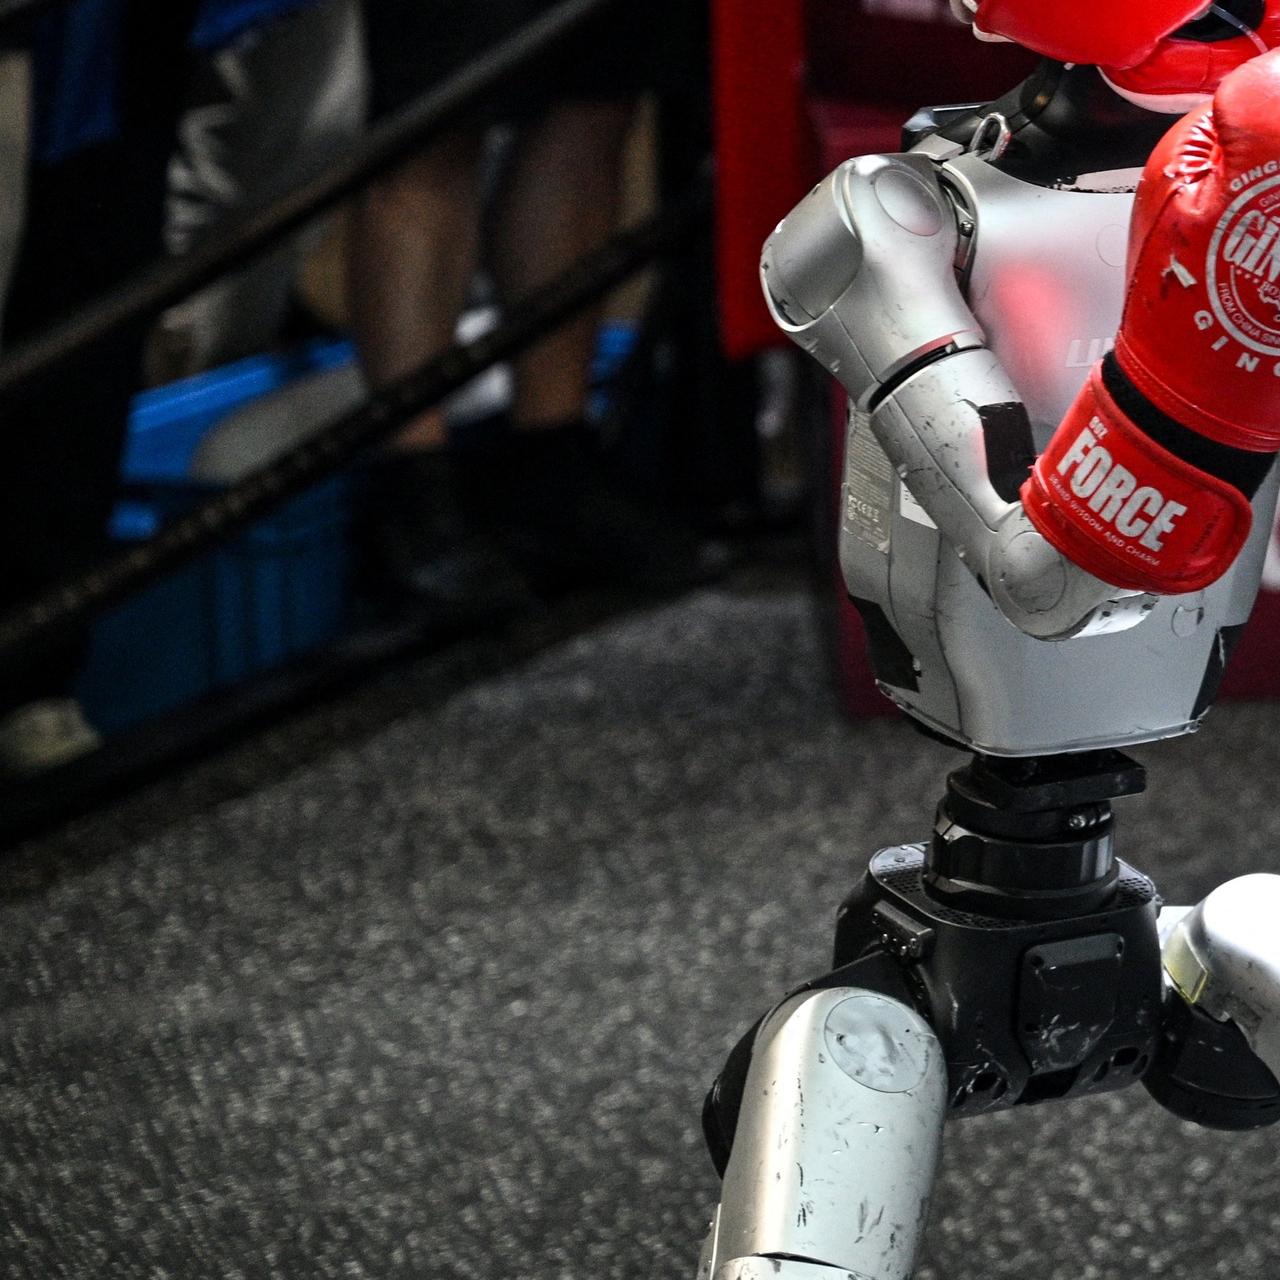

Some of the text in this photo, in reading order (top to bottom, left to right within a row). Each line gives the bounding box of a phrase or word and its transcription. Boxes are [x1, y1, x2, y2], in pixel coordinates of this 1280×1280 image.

[1218, 282, 1237, 314] FROM
[1232, 314, 1262, 338] CHINA
[1050, 474, 1160, 566] BRAND WISDOM AND CHARM
[1056, 427, 1188, 552] FORCE
